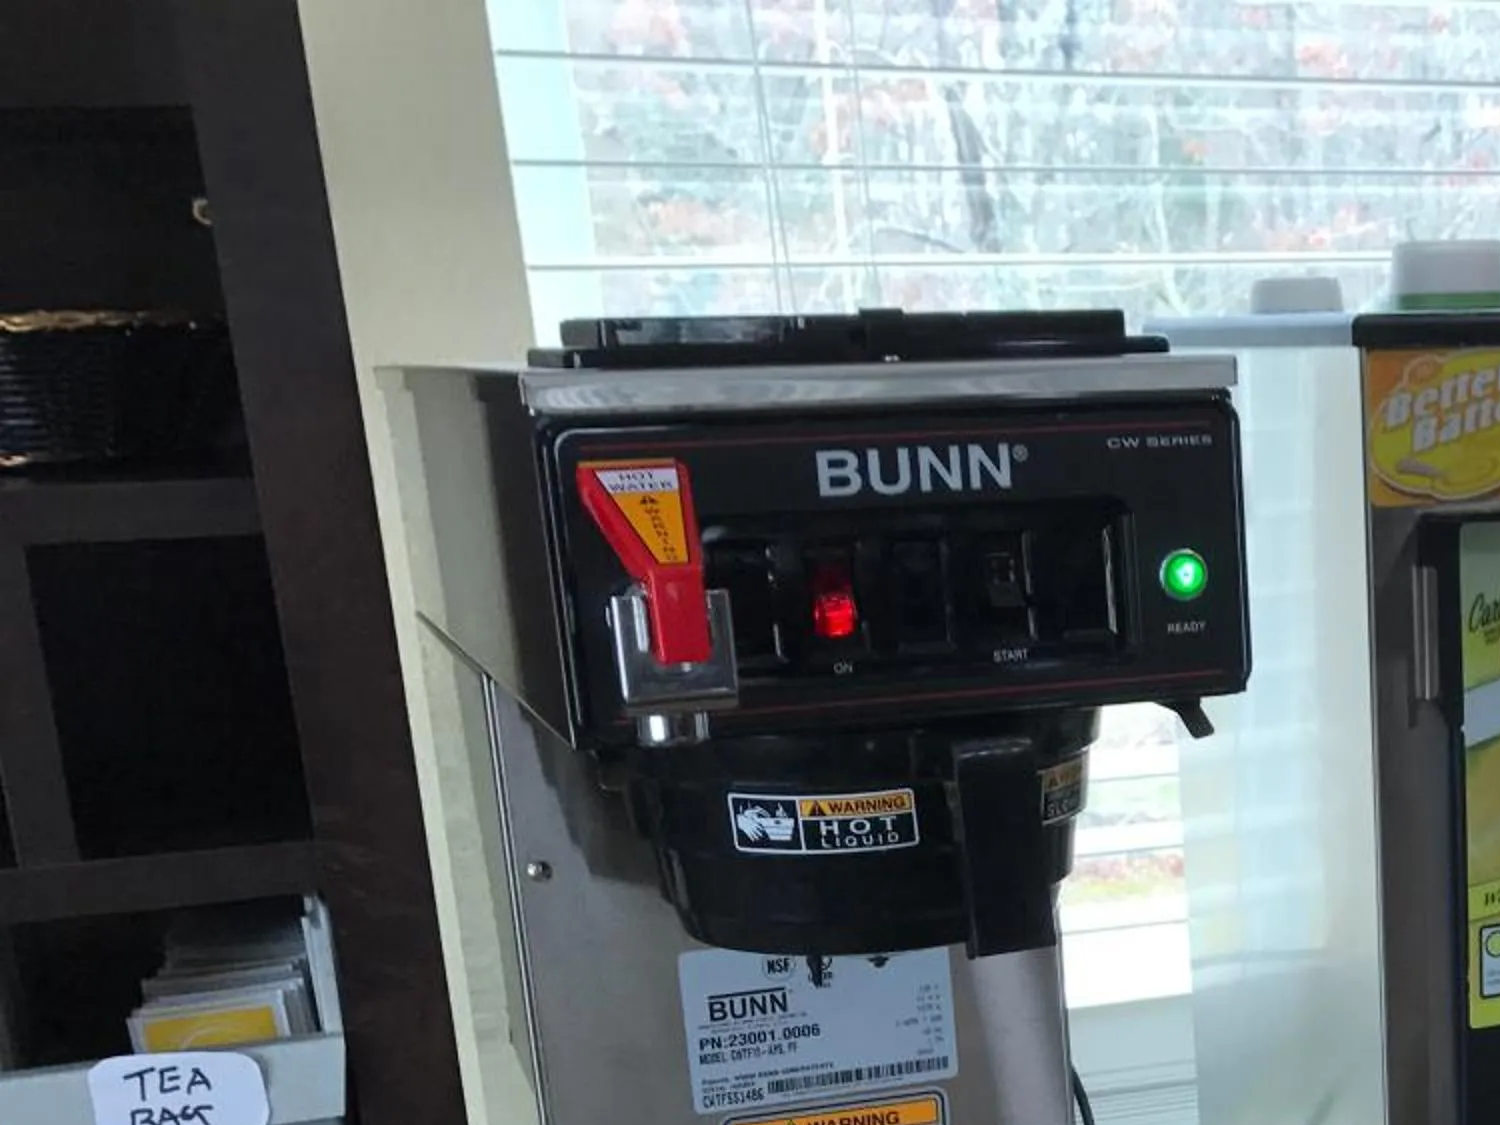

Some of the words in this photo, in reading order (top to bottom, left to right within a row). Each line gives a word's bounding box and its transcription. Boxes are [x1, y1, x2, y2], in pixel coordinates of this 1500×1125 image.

[1107, 436, 1139, 449] CW
[619, 471, 654, 481] HOT
[607, 480, 674, 492] WATER
[1166, 621, 1207, 635] READY
[993, 648, 1030, 663] START
[833, 662, 854, 675] ON
[828, 795, 907, 815] WARNING
[819, 815, 898, 836] HOT
[821, 831, 900, 849] LIQUID
[766, 957, 791, 975] NSF
[708, 991, 789, 1022] BUNN
[699, 1050, 728, 1066] MODEL
[122, 1066, 213, 1101] TEA
